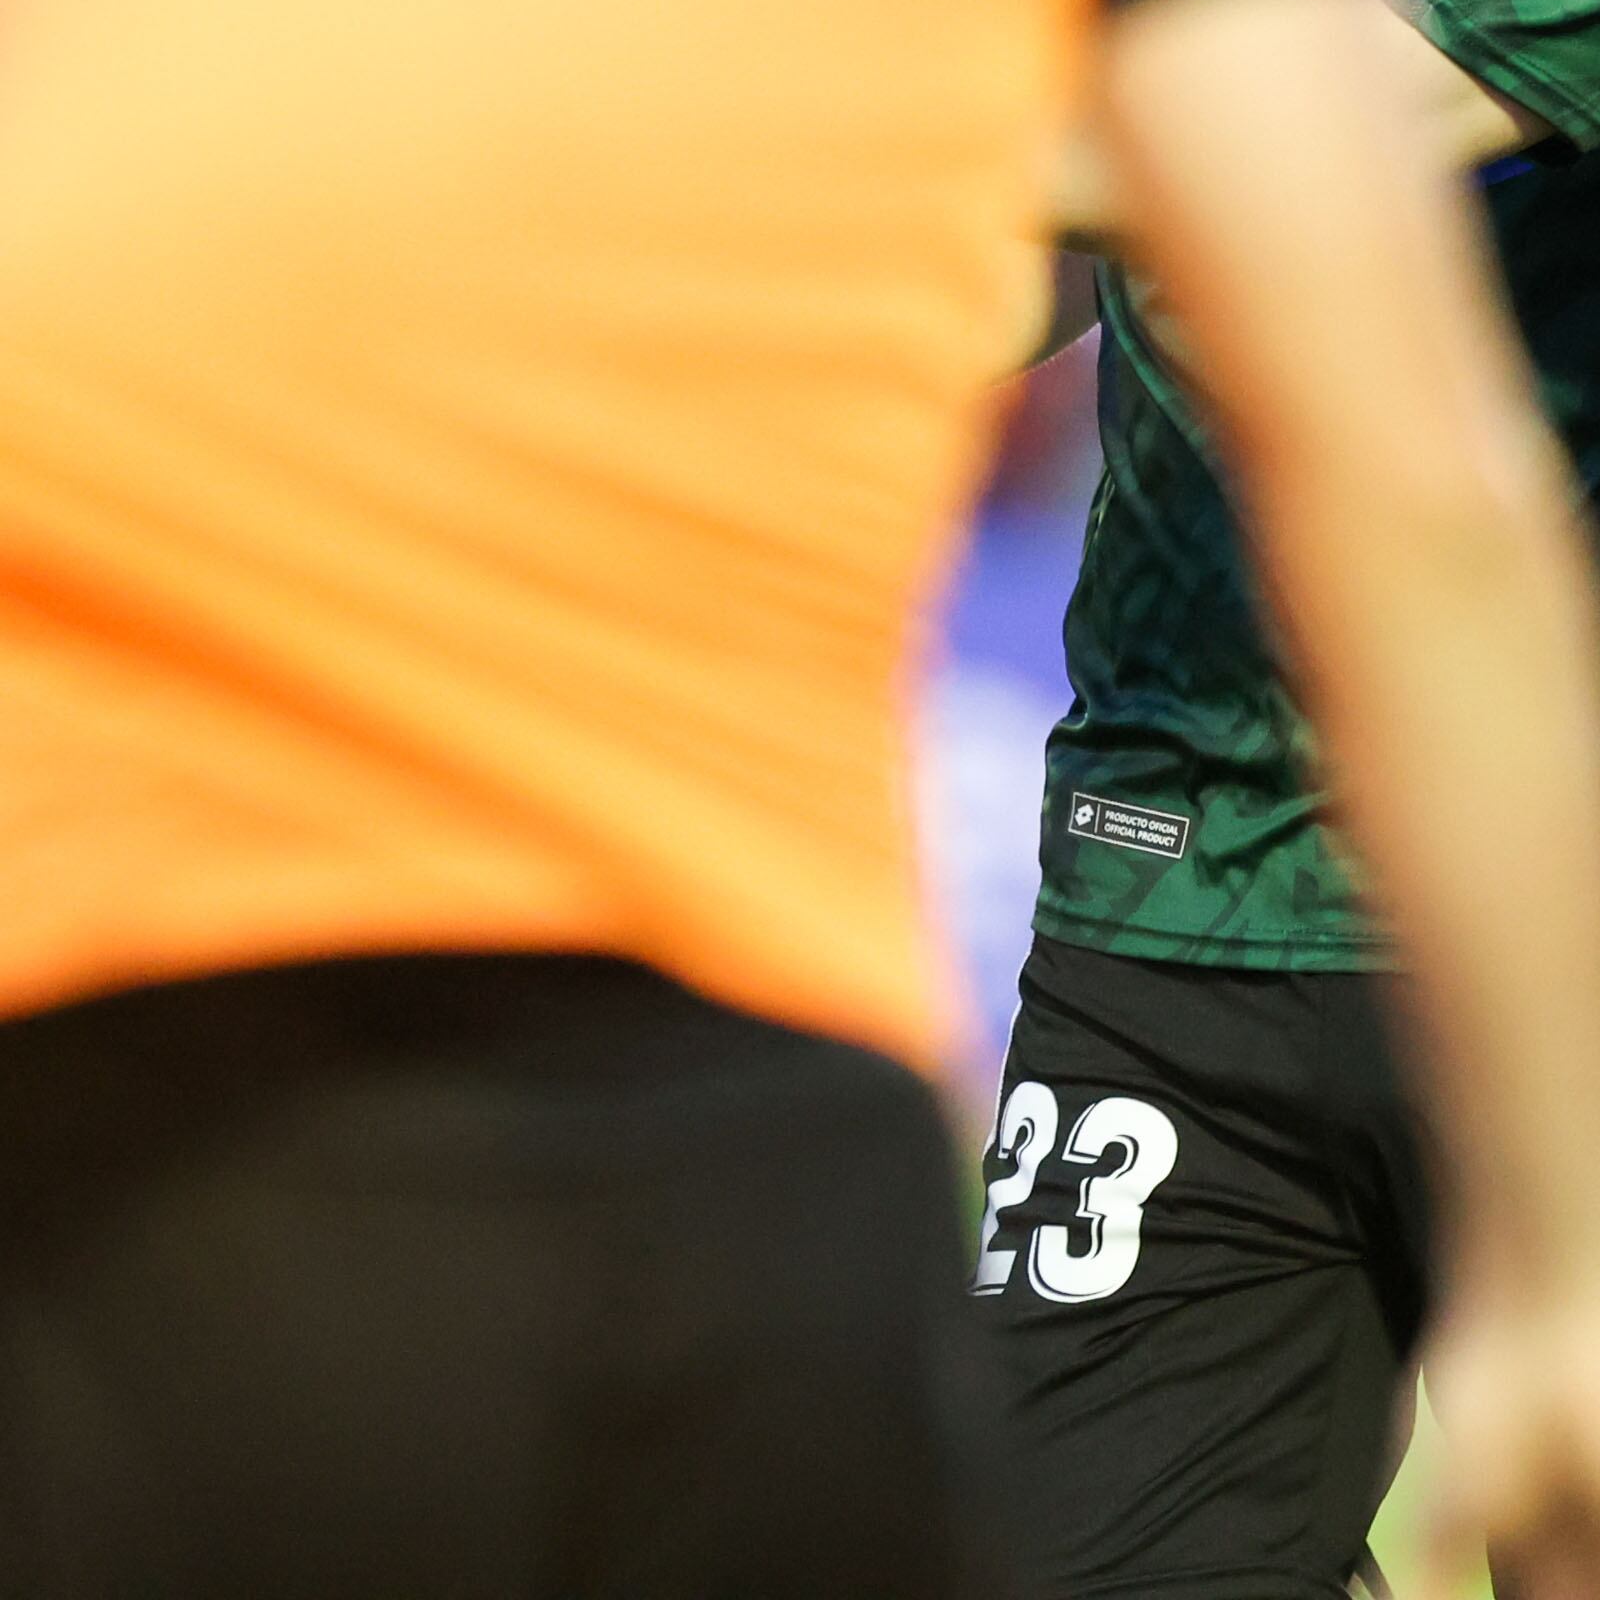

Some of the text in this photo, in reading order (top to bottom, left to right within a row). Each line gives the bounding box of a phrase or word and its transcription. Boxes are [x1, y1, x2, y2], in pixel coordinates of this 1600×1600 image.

[1103, 822, 1176, 848] OFFICIAL PRODUCT
[1105, 810, 1179, 836] PRODUCTO OFICIAL
[969, 1080, 1179, 1304] 23
